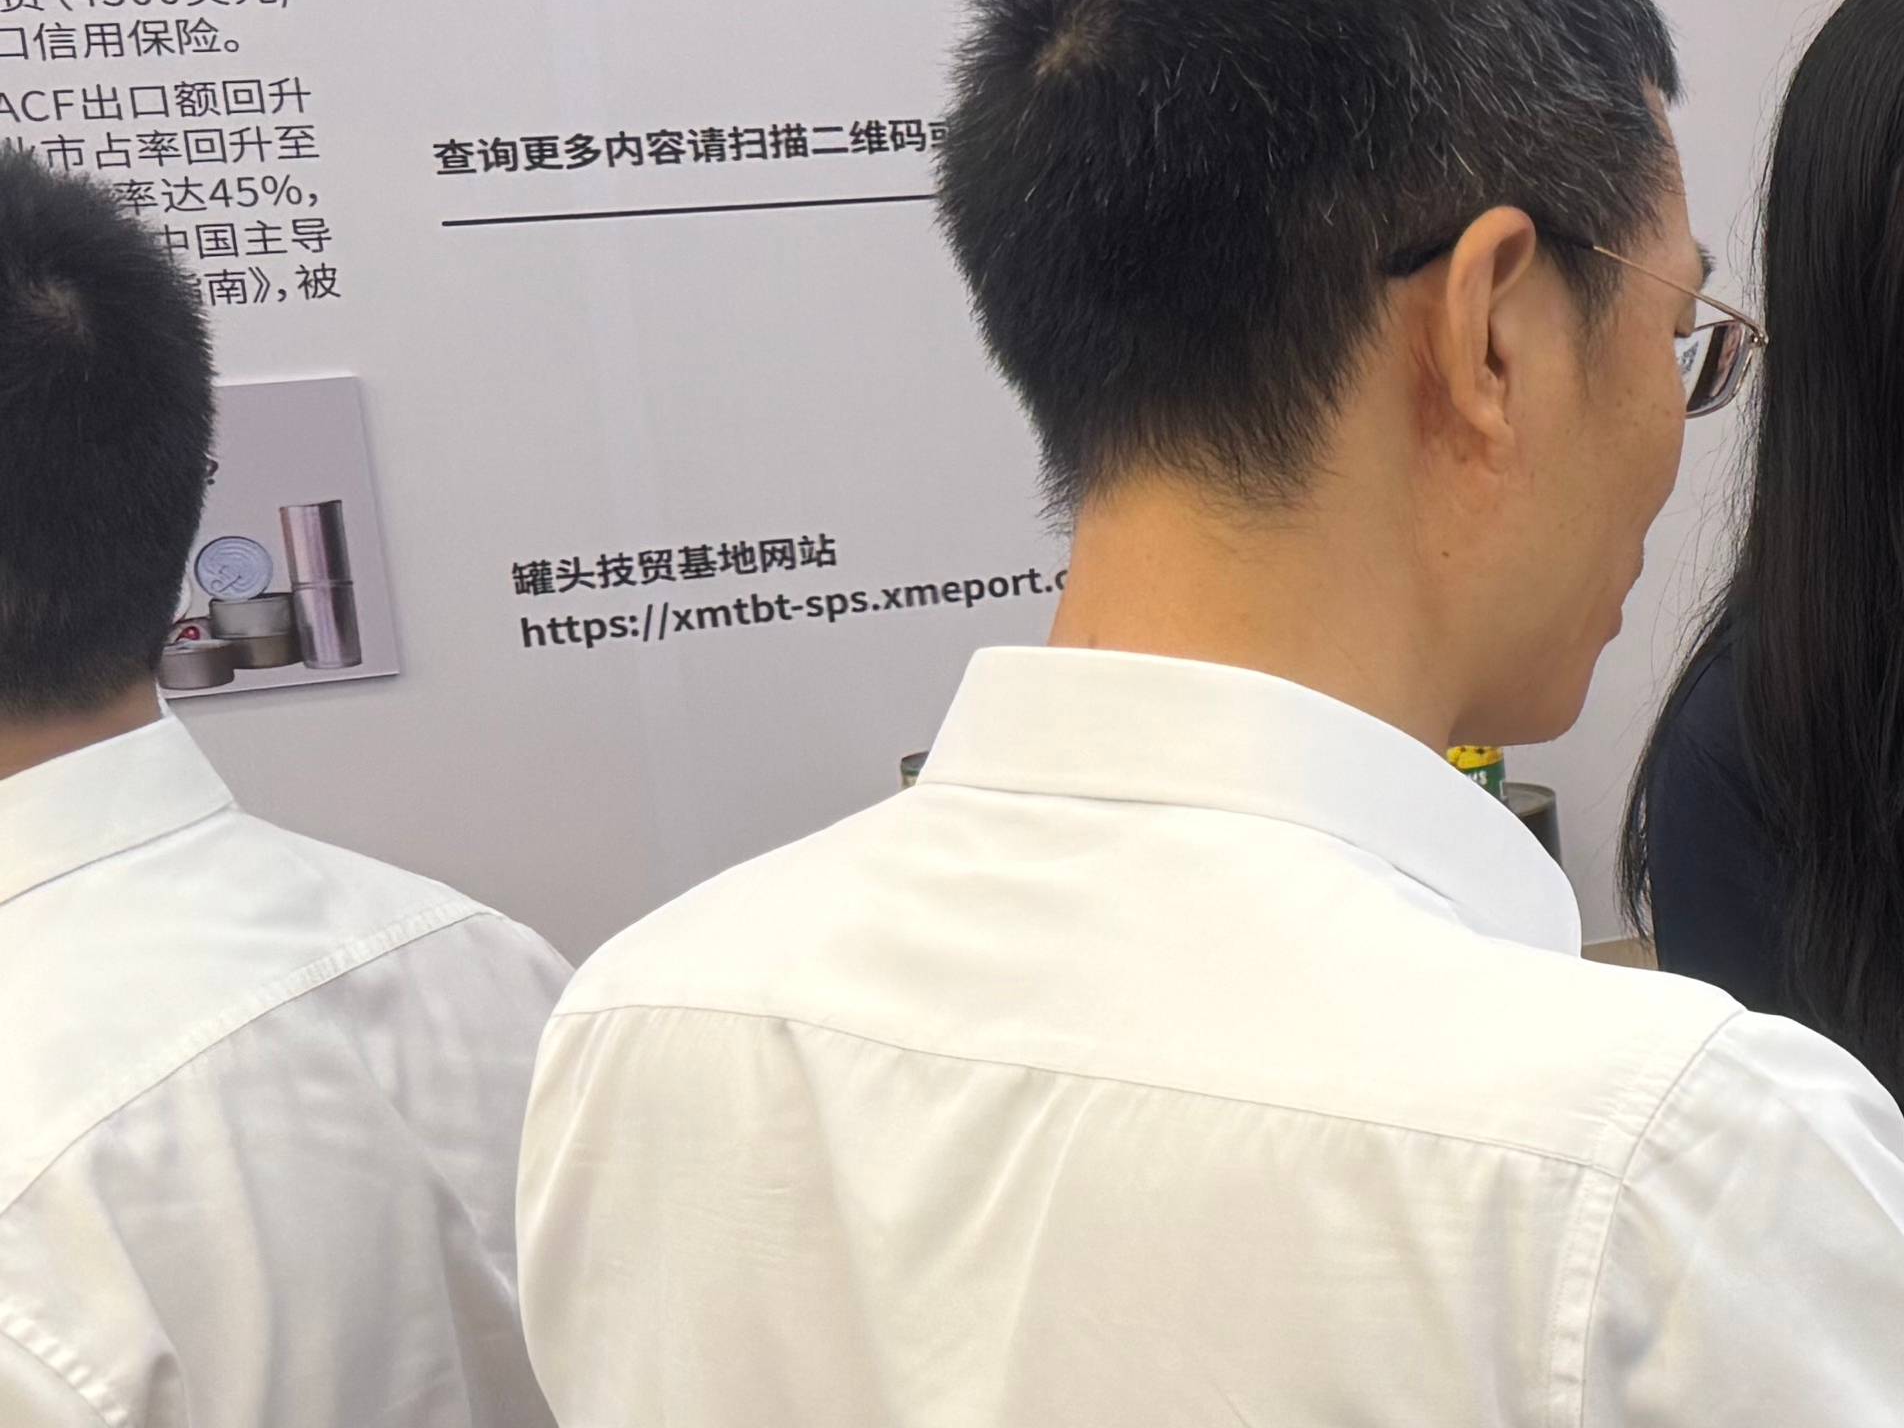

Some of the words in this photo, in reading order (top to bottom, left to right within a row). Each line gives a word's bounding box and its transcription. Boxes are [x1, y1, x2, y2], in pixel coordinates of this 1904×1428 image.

[511, 533, 837, 598] 罐头技贸基地网站
